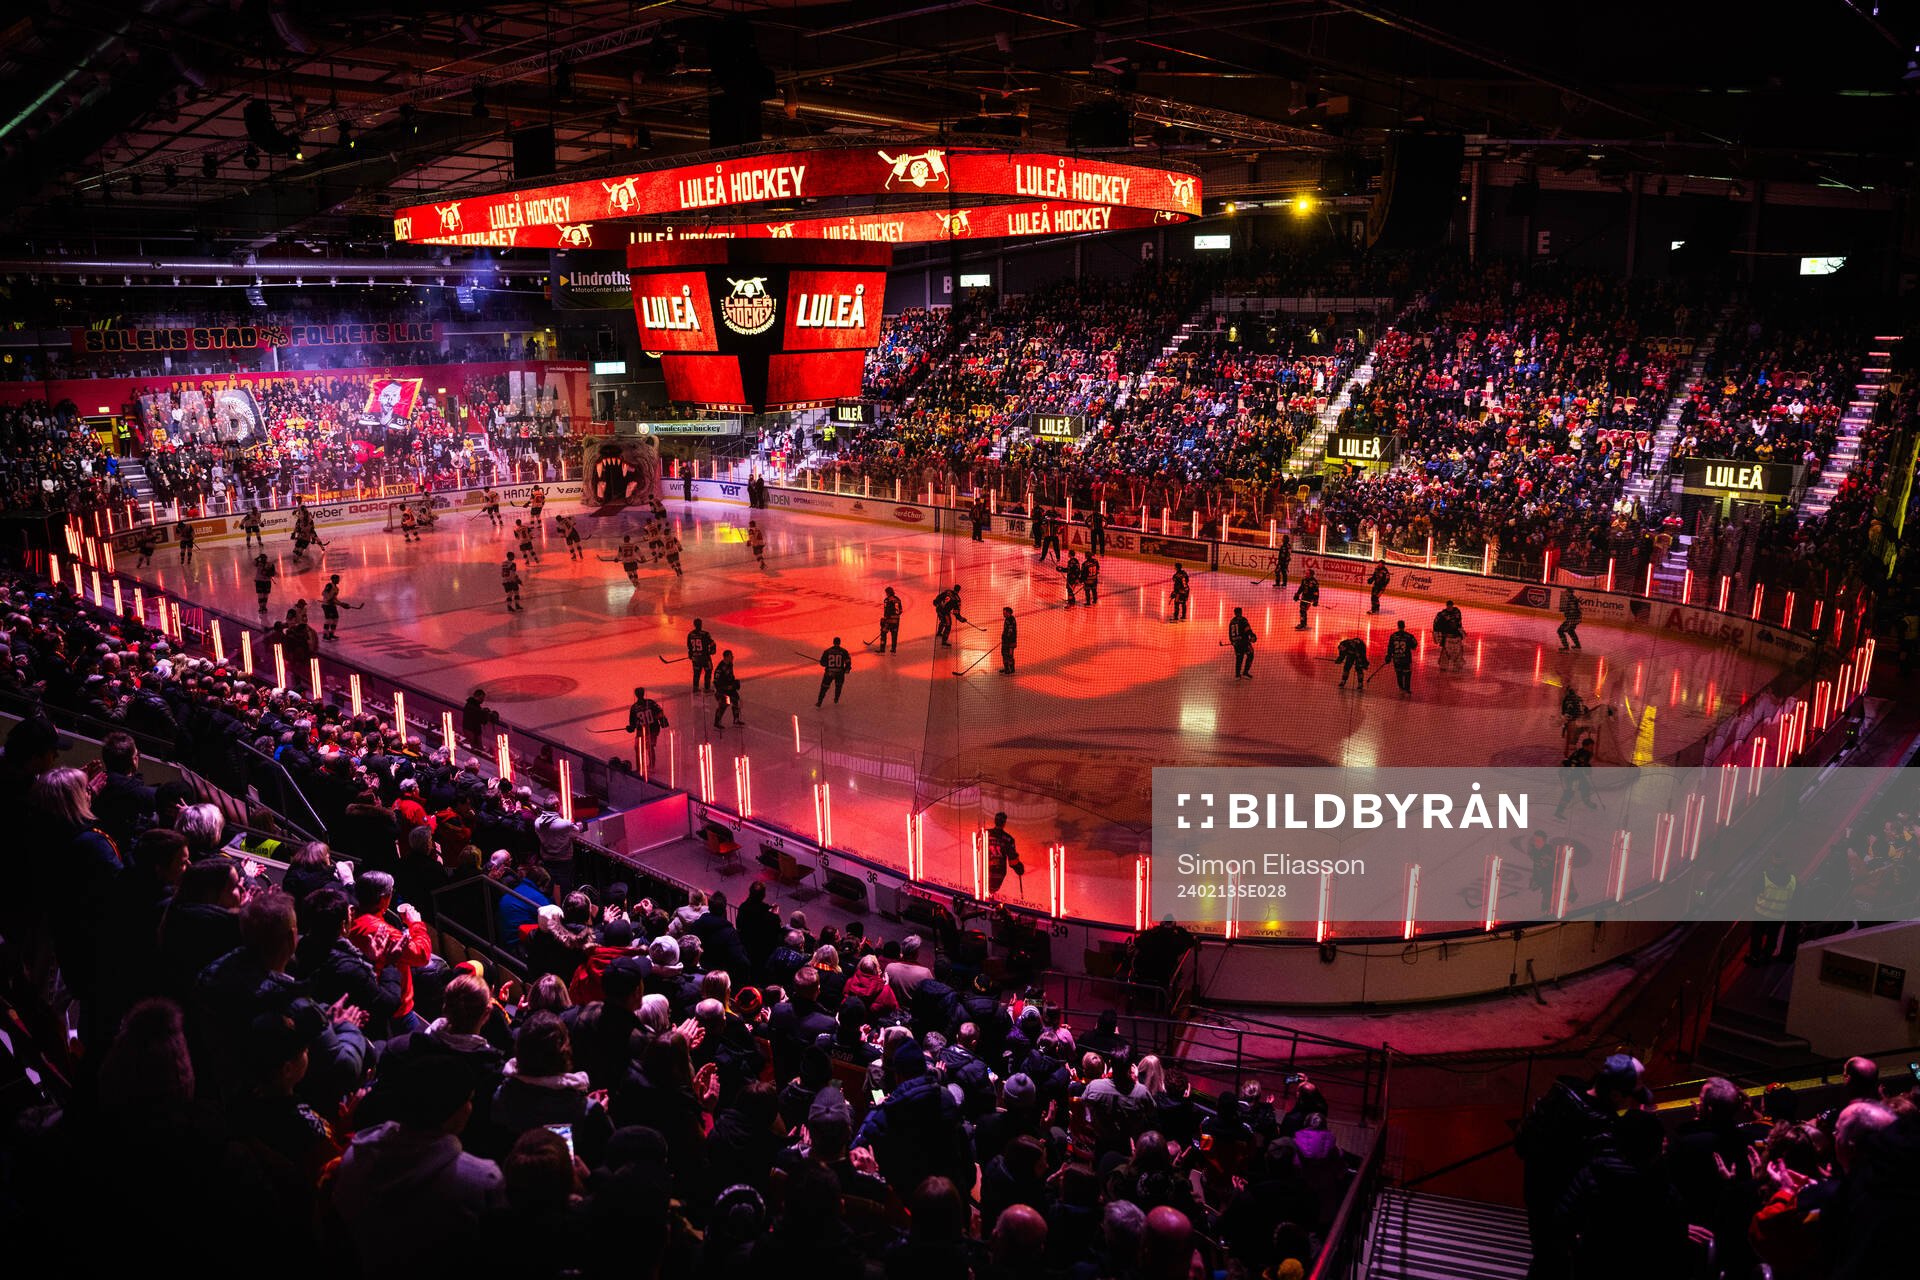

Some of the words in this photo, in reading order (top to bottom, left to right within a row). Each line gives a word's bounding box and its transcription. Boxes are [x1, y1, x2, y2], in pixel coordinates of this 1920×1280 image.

[679, 164, 727, 208] LULEÅ
[730, 165, 805, 202] HOCKEY
[1016, 159, 1067, 198] LULEÅ
[1073, 171, 1130, 204] HOCKEY
[489, 194, 524, 229] LULEÅ
[525, 196, 570, 226] HOCKEY
[1008, 204, 1050, 235] LULEÅ
[1055, 206, 1111, 232] HOCKEY
[860, 221, 904, 242] HOCKEY
[570, 270, 631, 287] Lindroths
[641, 285, 700, 330] LULEÅ
[725, 294, 773, 307] LULEÅ
[796, 284, 865, 328] LULEÅ
[726, 307, 773, 328] HOCKEY
[86, 329, 187, 352] SOLENS
[193, 327, 257, 349] STAD
[291, 323, 390, 346] FOLKETS
[394, 322, 433, 342] LAG
[838, 403, 863, 422] LULEÅ
[1039, 416, 1071, 436] LULEÅ
[1338, 436, 1382, 459] LULEÅ
[1705, 464, 1763, 491] LULEÅ
[719, 484, 741, 497] YBT
[1302, 557, 1320, 569] ICA
[1596, 598, 1624, 611] home
[773, 836, 783, 848] 34
[867, 871, 878, 884] 36
